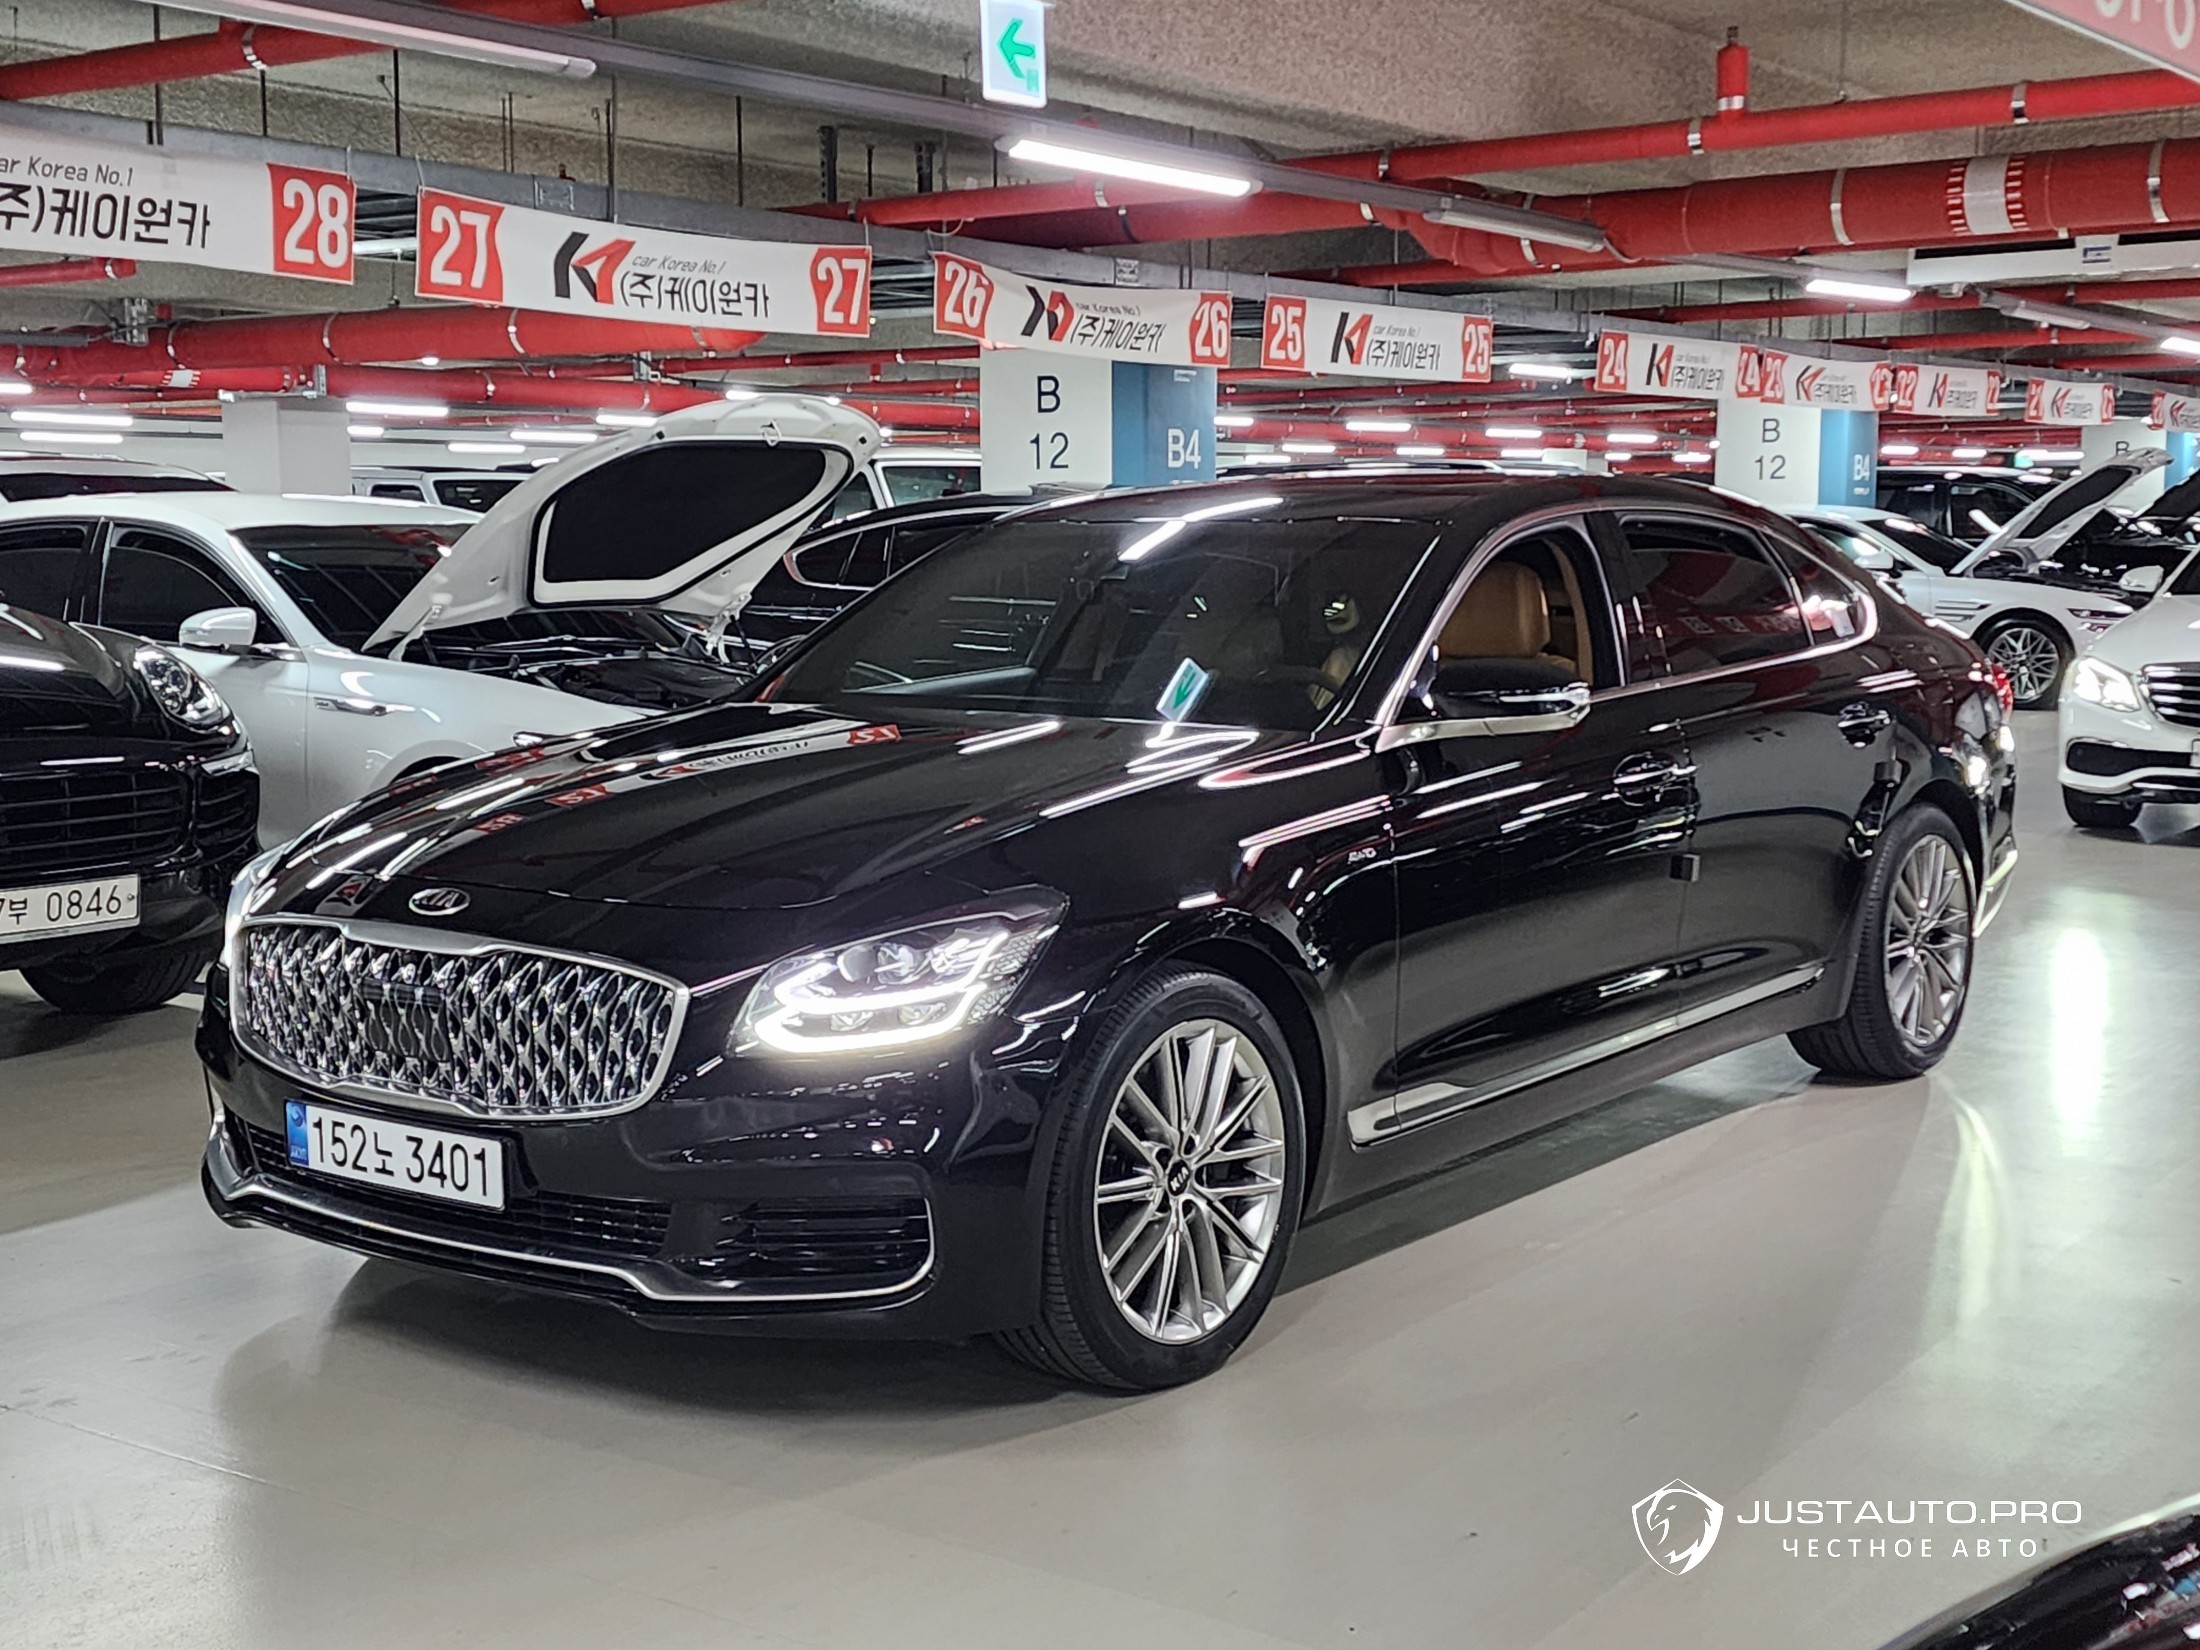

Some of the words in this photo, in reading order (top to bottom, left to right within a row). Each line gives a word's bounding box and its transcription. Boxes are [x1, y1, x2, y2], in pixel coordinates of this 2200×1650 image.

[27, 155, 88, 182] Korea
[95, 164, 133, 187] No.1
[282, 177, 349, 269] 28
[429, 204, 491, 289] 27
[632, 254, 657, 268] car
[658, 254, 698, 273] Korea
[699, 259, 726, 275] No.1
[620, 270, 769, 318] (주)케이원카
[816, 255, 868, 325] 27
[944, 259, 989, 329] 26
[1194, 299, 1229, 359] 26
[1269, 303, 1303, 361] 25
[1464, 322, 1490, 374] 25
[1601, 338, 1627, 385] 24
[1737, 352, 1760, 393] 24
[1037, 375, 1061, 413] B
[1168, 428, 1201, 469] B4
[1762, 418, 1781, 442] B
[1030, 433, 1069, 469] 12
[1754, 455, 1786, 480] 12
[1853, 454, 1870, 481] B4
[47, 885, 121, 922] 0846
